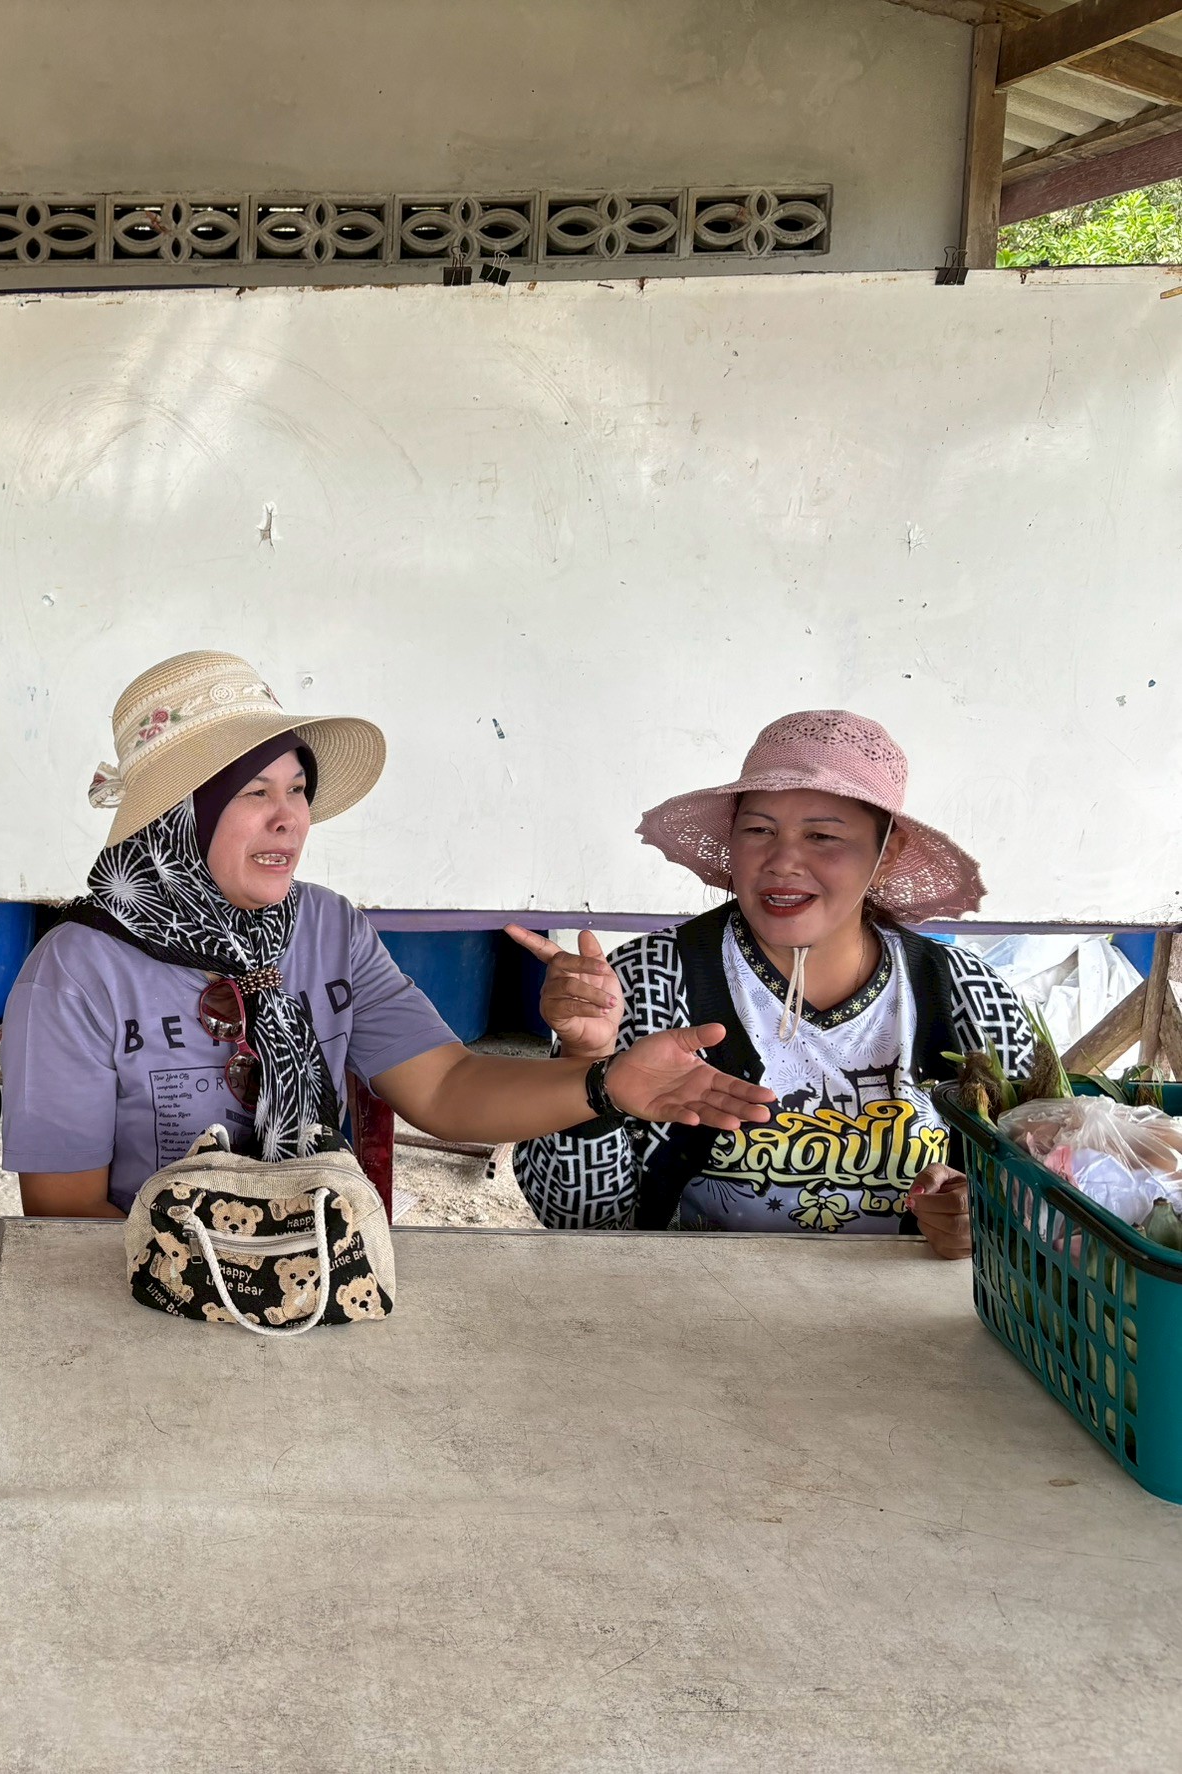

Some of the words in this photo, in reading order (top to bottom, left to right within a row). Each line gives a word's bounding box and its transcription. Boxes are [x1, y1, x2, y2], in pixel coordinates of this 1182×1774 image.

[218, 1263, 252, 1284] Happy
[146, 1282, 167, 1306] Little
[205, 1274, 234, 1291] Lie
[237, 1282, 265, 1297] Bear
